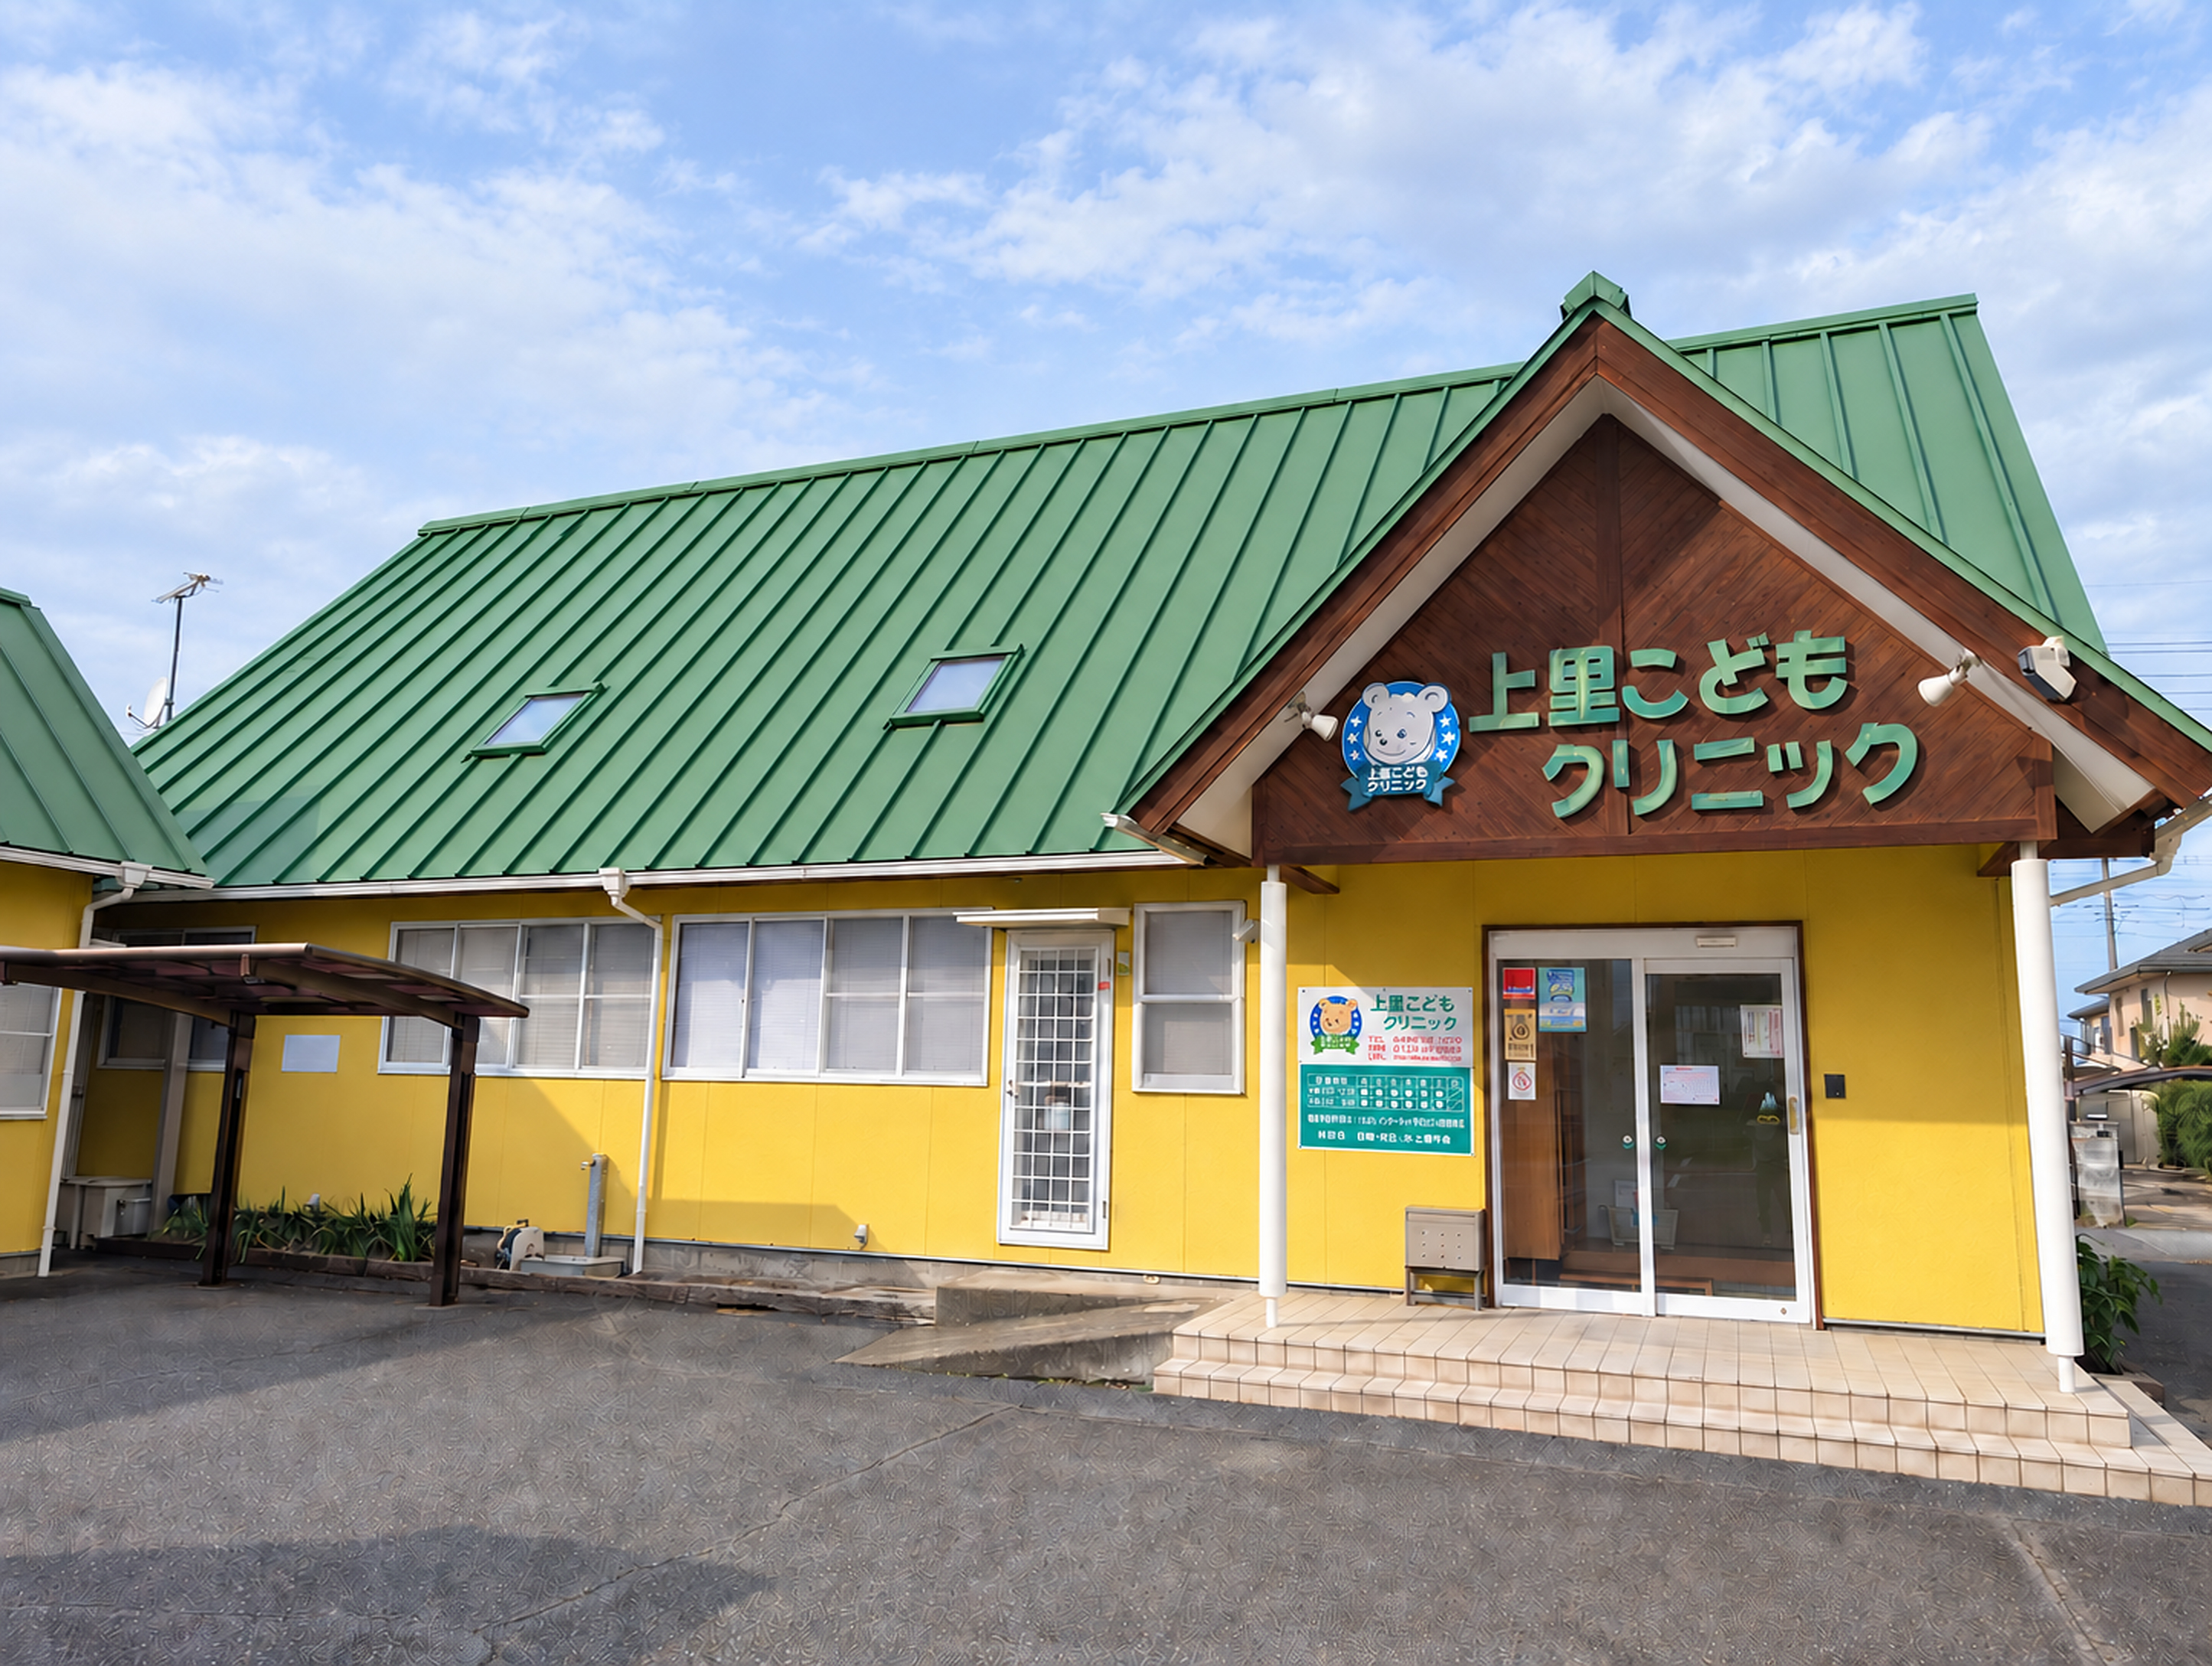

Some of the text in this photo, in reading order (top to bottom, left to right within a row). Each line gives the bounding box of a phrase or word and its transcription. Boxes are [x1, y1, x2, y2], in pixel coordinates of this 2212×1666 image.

[1468, 630, 1848, 733] 上里こども
[1542, 722, 1917, 819] クリニック
[1383, 1014, 1457, 1031] クリニック
